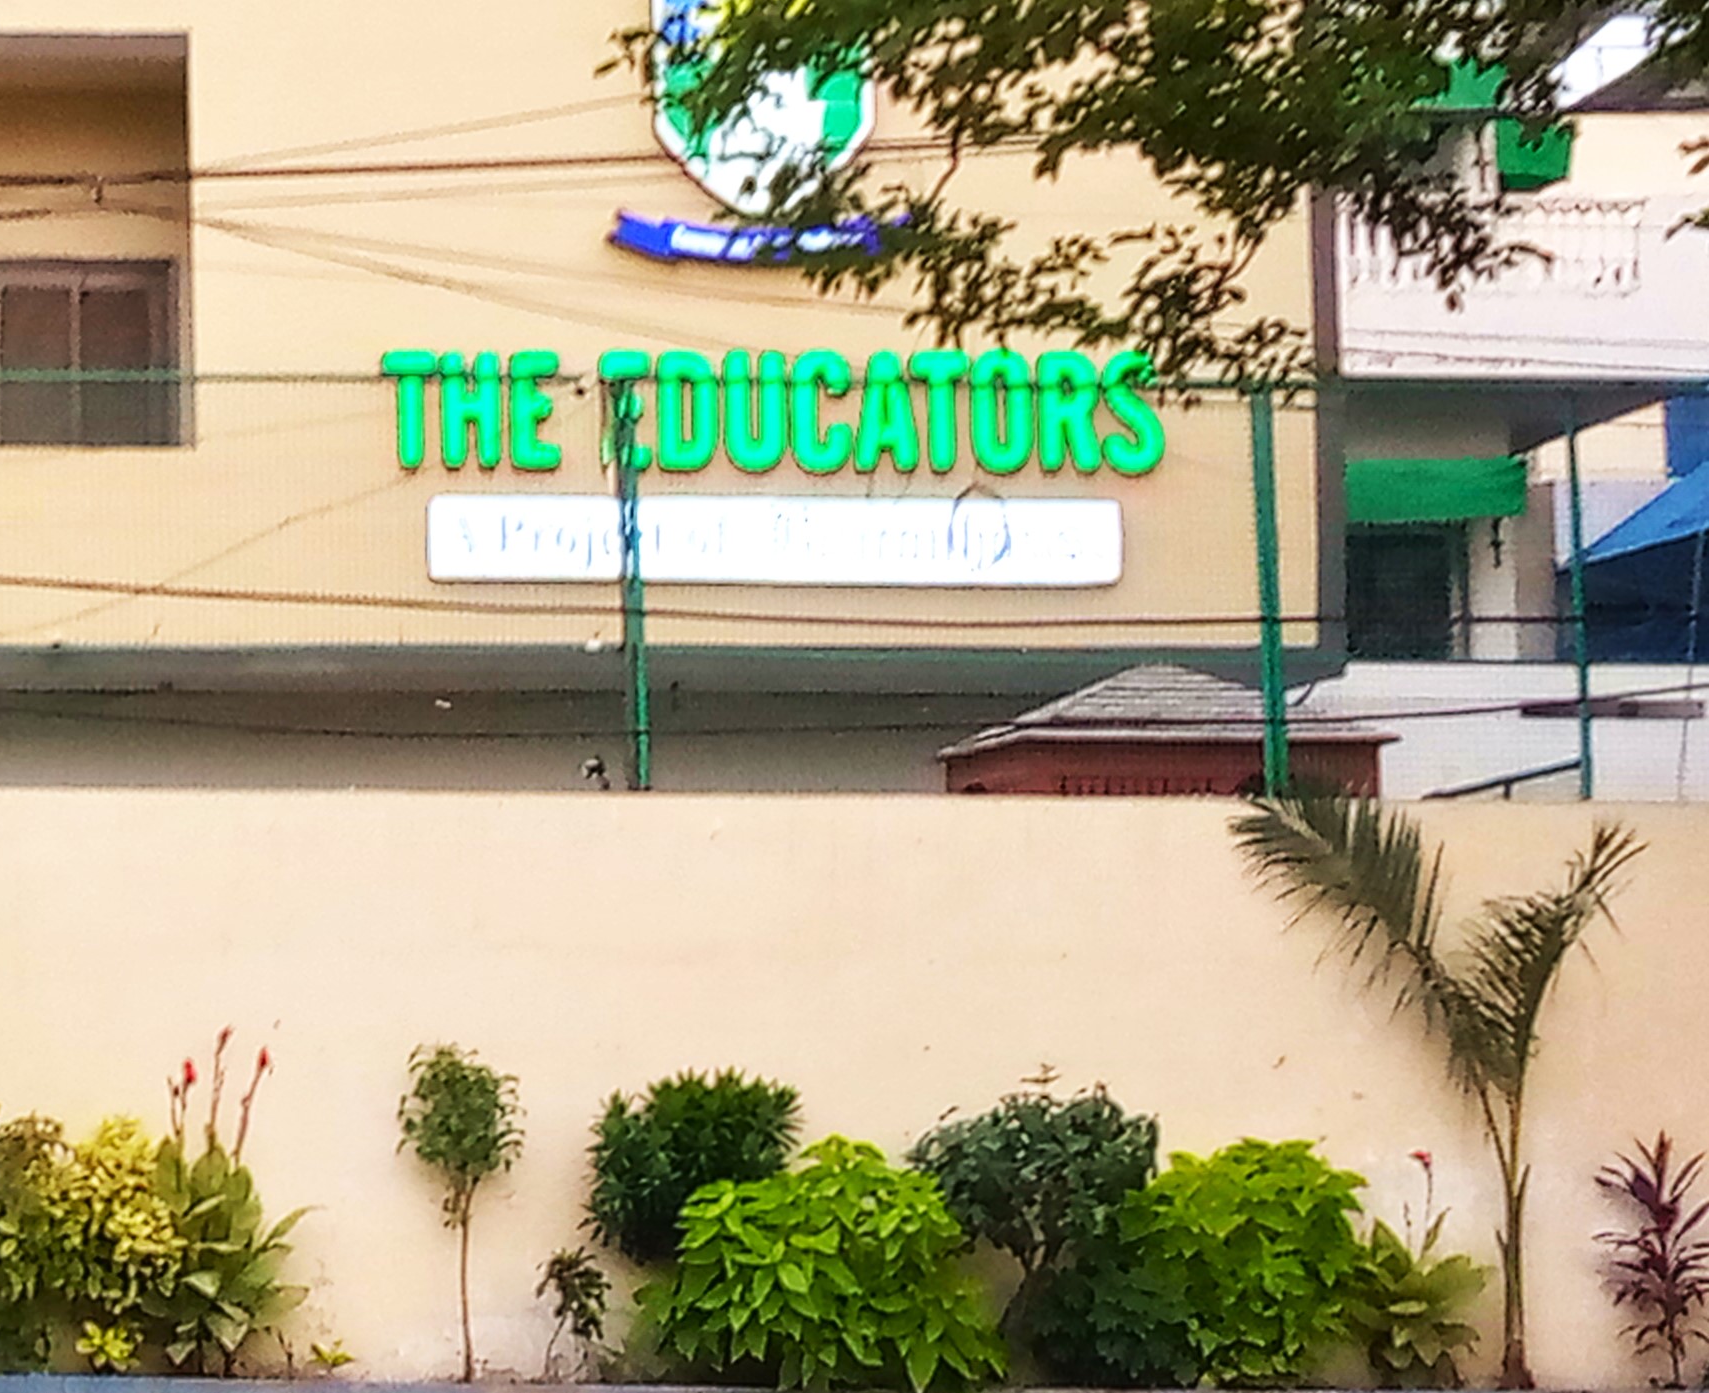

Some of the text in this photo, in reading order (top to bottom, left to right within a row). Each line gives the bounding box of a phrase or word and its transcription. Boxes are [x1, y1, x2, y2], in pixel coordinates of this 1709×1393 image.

[382, 348, 1166, 473] THE EDUCATORS
[499, 513, 665, 570] Projet
